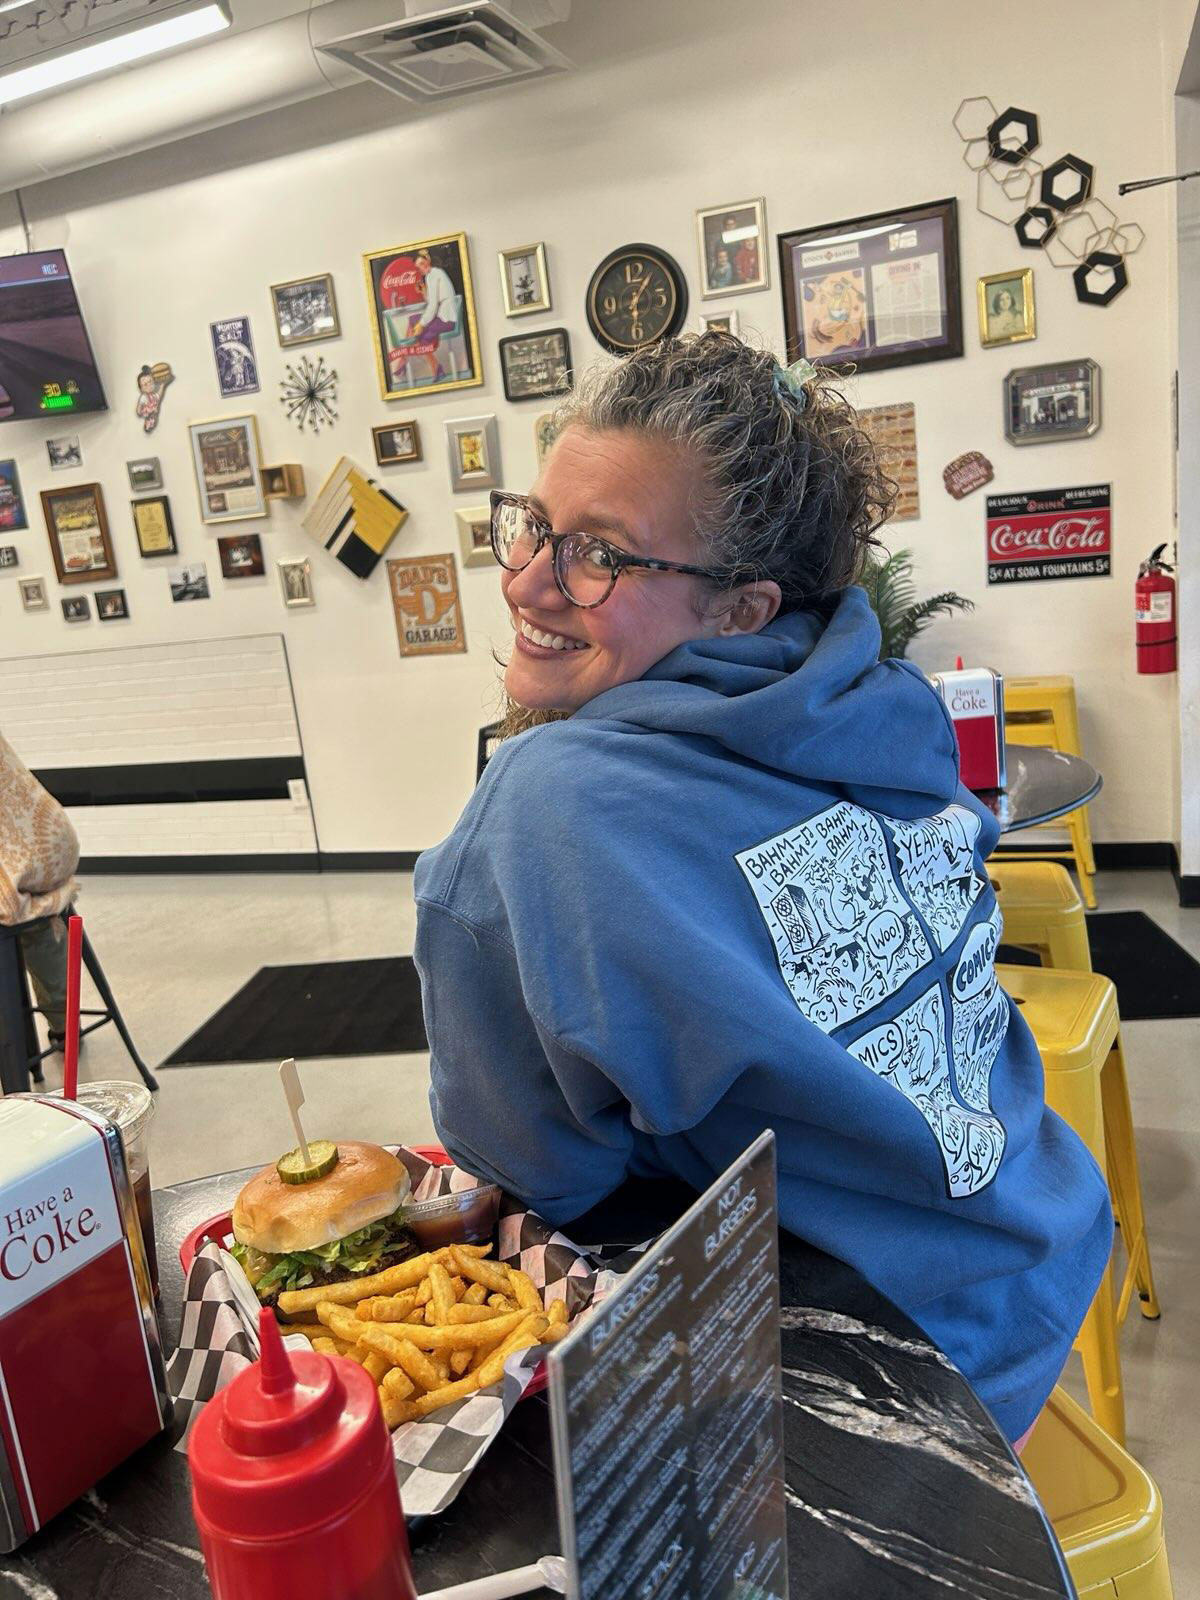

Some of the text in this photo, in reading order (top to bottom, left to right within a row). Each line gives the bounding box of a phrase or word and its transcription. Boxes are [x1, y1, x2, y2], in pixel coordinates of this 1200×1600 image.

[626, 262, 643, 283] 12
[604, 296, 617, 315] 9
[631, 323, 643, 340] 6
[1065, 488, 1109, 499] REFRESHING
[991, 516, 1105, 555] Coca-Cola
[1004, 567, 1016, 579] AT
[1017, 566, 1040, 578] SODA
[1043, 561, 1095, 576] FOUNTAINS
[406, 628, 457, 643] GARAGE
[955, 688, 975, 697] Have
[951, 696, 988, 712] Coke
[858, 1029, 897, 1068] MICS
[4, 1187, 73, 1236] Have a
[0, 1208, 97, 1280] Coke
